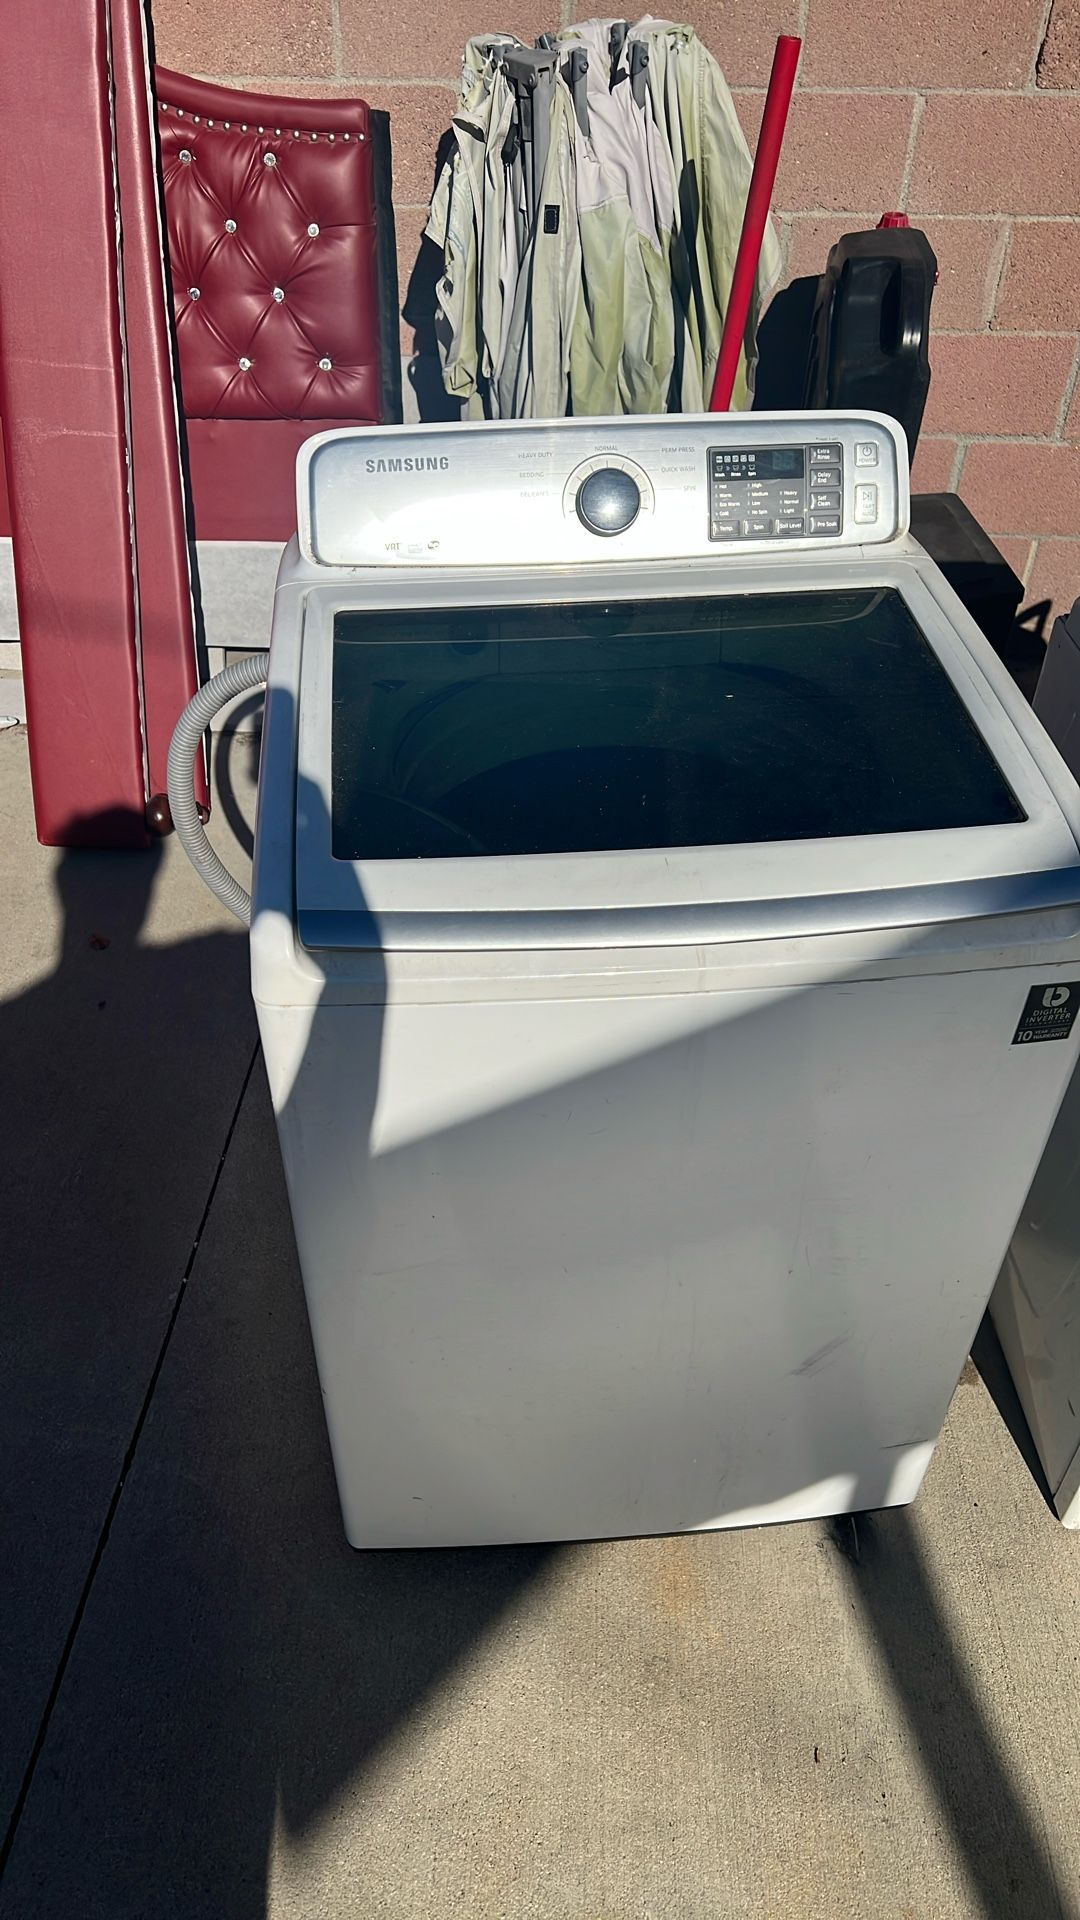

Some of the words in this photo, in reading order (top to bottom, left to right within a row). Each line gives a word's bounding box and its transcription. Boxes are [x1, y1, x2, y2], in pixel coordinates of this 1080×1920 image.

[365, 456, 449, 473] SAMSUNG
[1032, 1007, 1068, 1017] DIGITAL
[1025, 1013, 1071, 1023] INVERTER
[1017, 1030, 1033, 1042] 10
